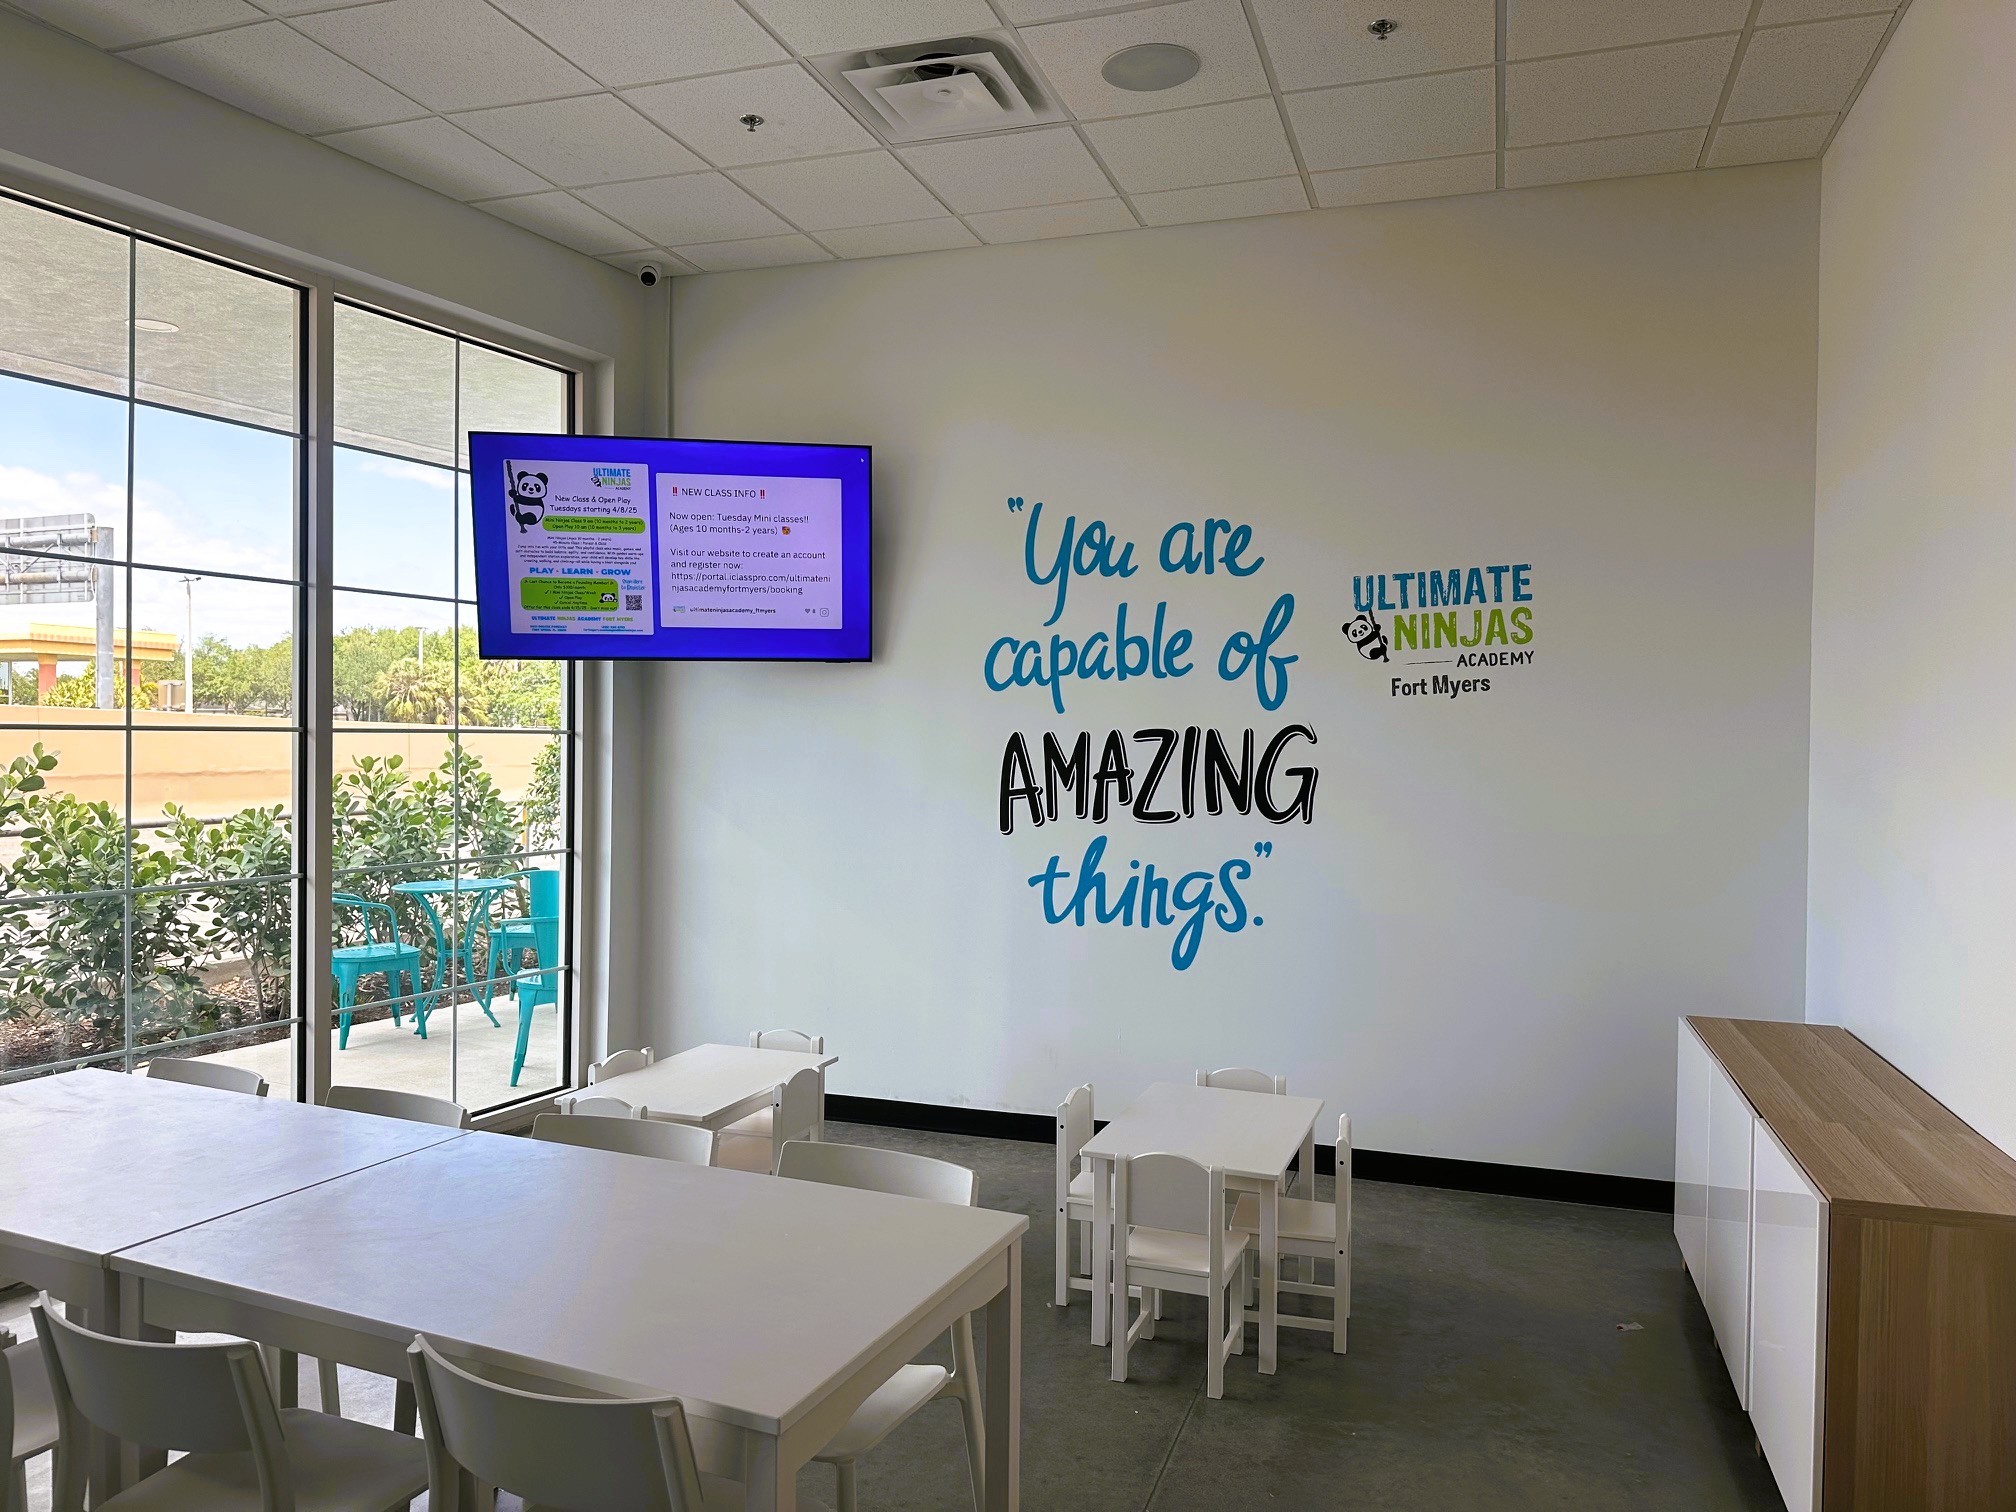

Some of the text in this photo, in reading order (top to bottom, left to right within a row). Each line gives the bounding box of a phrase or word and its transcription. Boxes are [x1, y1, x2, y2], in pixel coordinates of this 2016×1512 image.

[593, 468, 631, 477] ULTIMATE
[602, 477, 631, 486] NINJAS
[681, 488, 702, 496] NEW
[704, 488, 732, 497] CLASS
[734, 489, 756, 498] INFO
[617, 497, 631, 505] Play
[550, 504, 581, 513] Tuesdays
[583, 506, 611, 514] starting
[669, 512, 809, 523] Now open: Tuesday Mini classes!!
[669, 524, 778, 535] (Ages 10 months-2 years)
[670, 548, 689, 556] Visit
[707, 549, 740, 558] website
[1159, 518, 1265, 577] are
[689, 561, 721, 570] register
[672, 585, 803, 595] njasacademyfortmyers/booking
[1353, 564, 1532, 612] ULTIMATE
[1394, 607, 1533, 651] NINJAS
[984, 594, 1299, 714] capable of
[1457, 651, 1534, 667] ACADEMY
[1392, 675, 1490, 699] Fort Myers
[999, 722, 1319, 835] AMAZING
